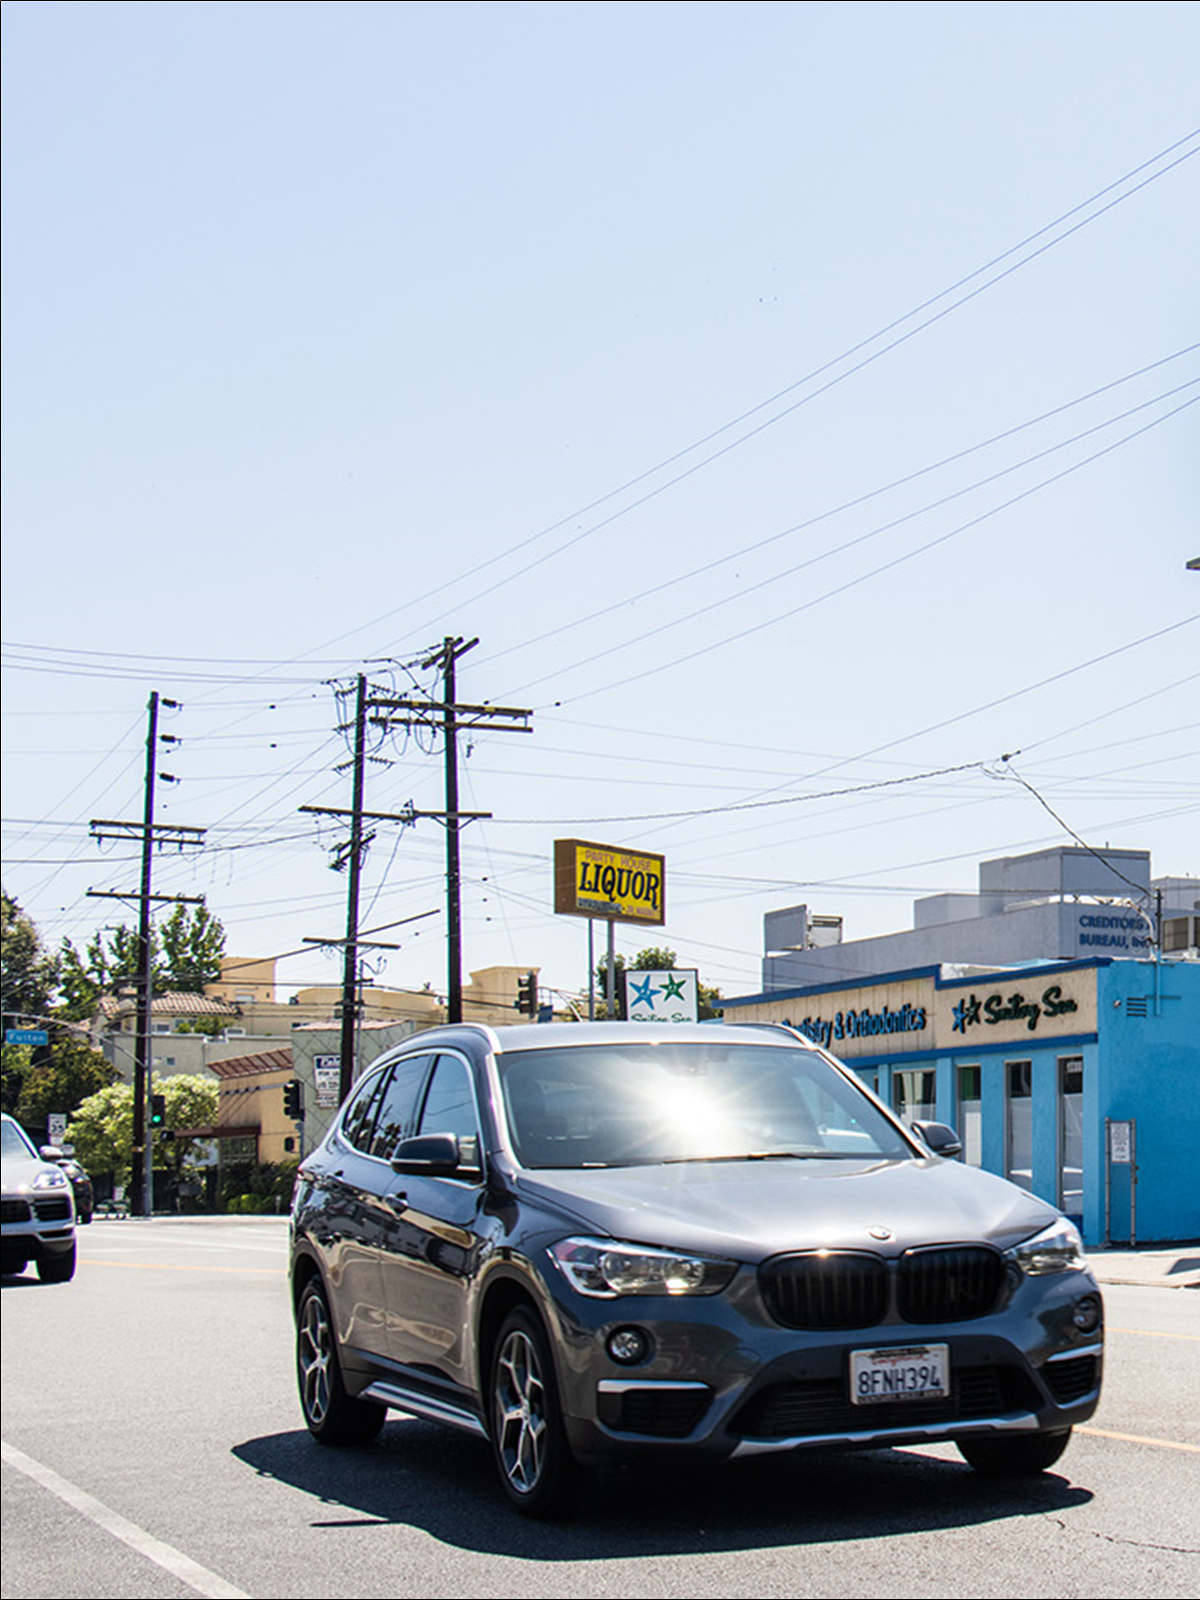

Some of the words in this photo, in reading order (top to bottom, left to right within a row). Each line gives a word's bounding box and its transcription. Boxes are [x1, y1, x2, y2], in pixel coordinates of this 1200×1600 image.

[585, 849, 614, 864] PARTY
[621, 855, 652, 872] HOUSE
[578, 861, 660, 911] LIQUOR
[1079, 915, 1144, 930] CREDITORS
[1042, 986, 1078, 1017] Sea
[834, 1012, 844, 1040] &
[845, 1003, 926, 1039] Orthodontics
[858, 1365, 941, 1394] 8FNH394
